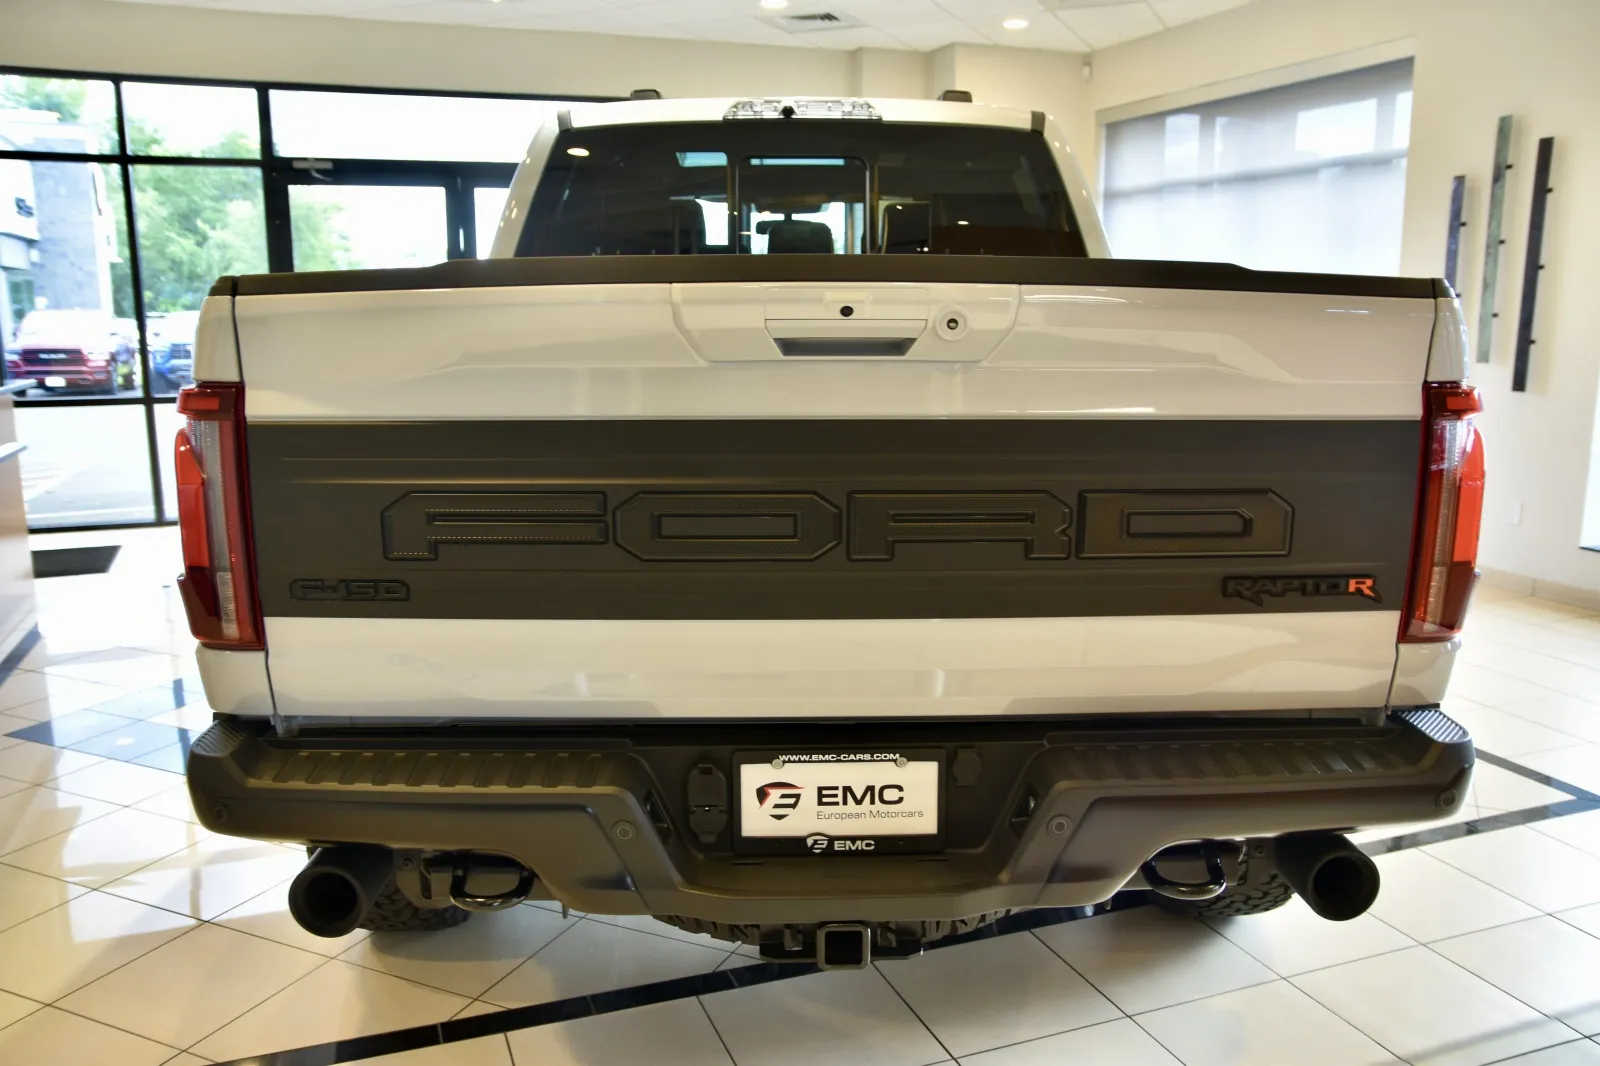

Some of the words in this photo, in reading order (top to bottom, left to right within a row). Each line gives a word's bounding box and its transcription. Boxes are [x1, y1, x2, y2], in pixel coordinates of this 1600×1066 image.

[381, 490, 1294, 562] FORD
[290, 579, 410, 601] F-150
[1222, 575, 1382, 607] RAPTOR
[778, 753, 900, 762] WWW.EMC-CARS.COM
[816, 784, 905, 807] EMC
[816, 811, 867, 821] European
[869, 809, 924, 819] Motorcars
[833, 840, 876, 851] EMC
